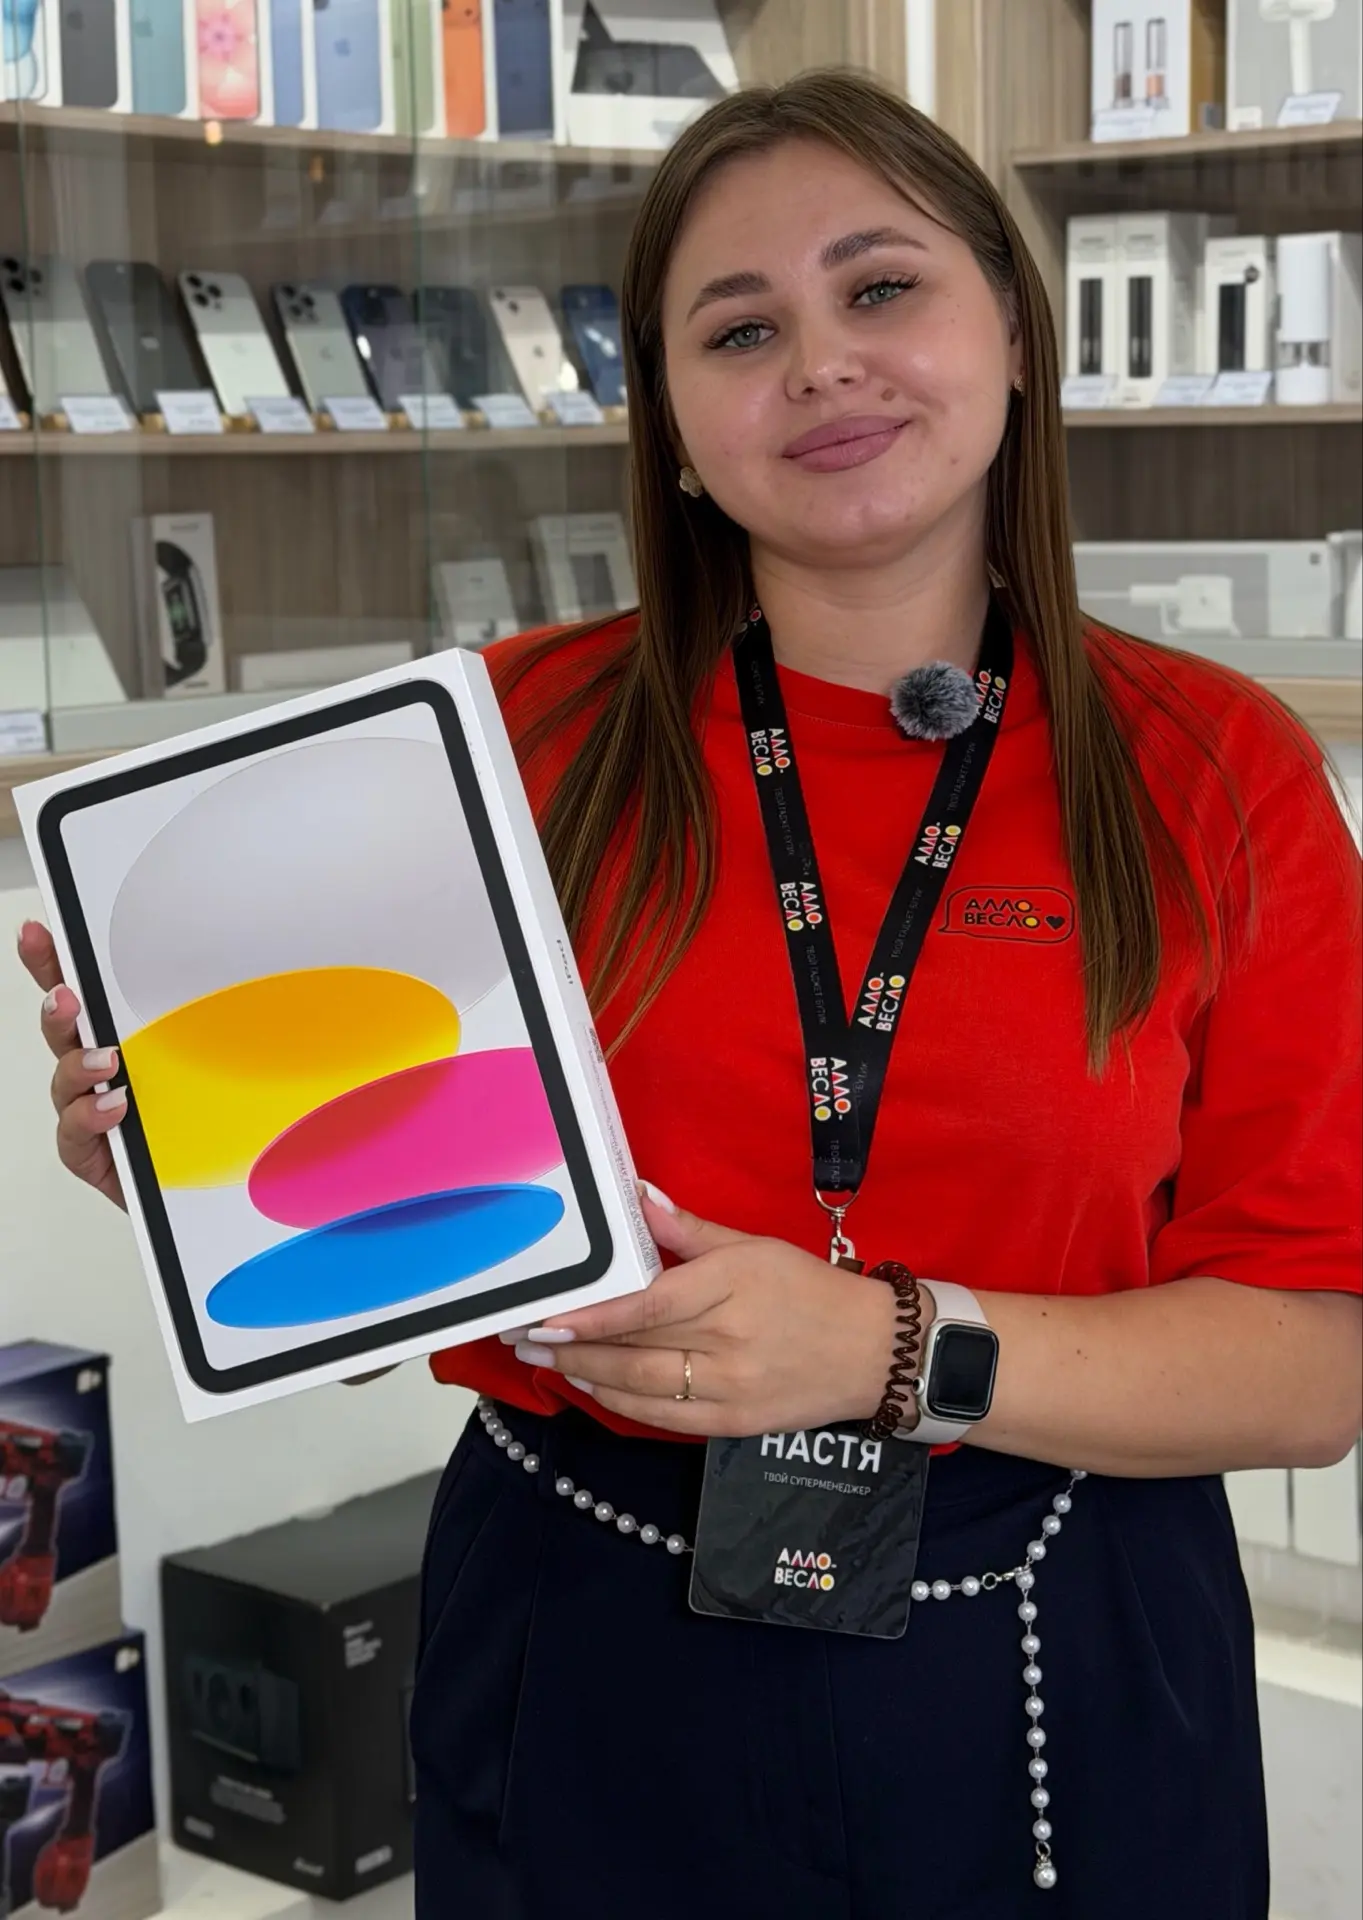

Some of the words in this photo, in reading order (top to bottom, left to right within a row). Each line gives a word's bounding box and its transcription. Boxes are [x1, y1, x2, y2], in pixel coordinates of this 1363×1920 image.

[983, 676, 1006, 724] ВЕСЛО
[750, 729, 773, 776] ВЕСЛО
[932, 824, 961, 869] ВЕСЛО
[780, 881, 804, 931] ВЕСЛО
[964, 911, 1040, 929] ВЕСЛО
[556, 939, 574, 984] iPad
[857, 971, 885, 1028] АЛЛО-
[875, 974, 905, 1032] ВЕСЛО
[810, 1057, 831, 1121] ВЕСЛО
[830, 1056, 851, 1120] АЛЛО-
[760, 1430, 882, 1473] НАСТЯ
[763, 1470, 789, 1484] ТВОЙ
[789, 1475, 872, 1496] СУПЕРМЕНЕДЖЕР
[773, 1566, 835, 1592] ВЕСЛО
